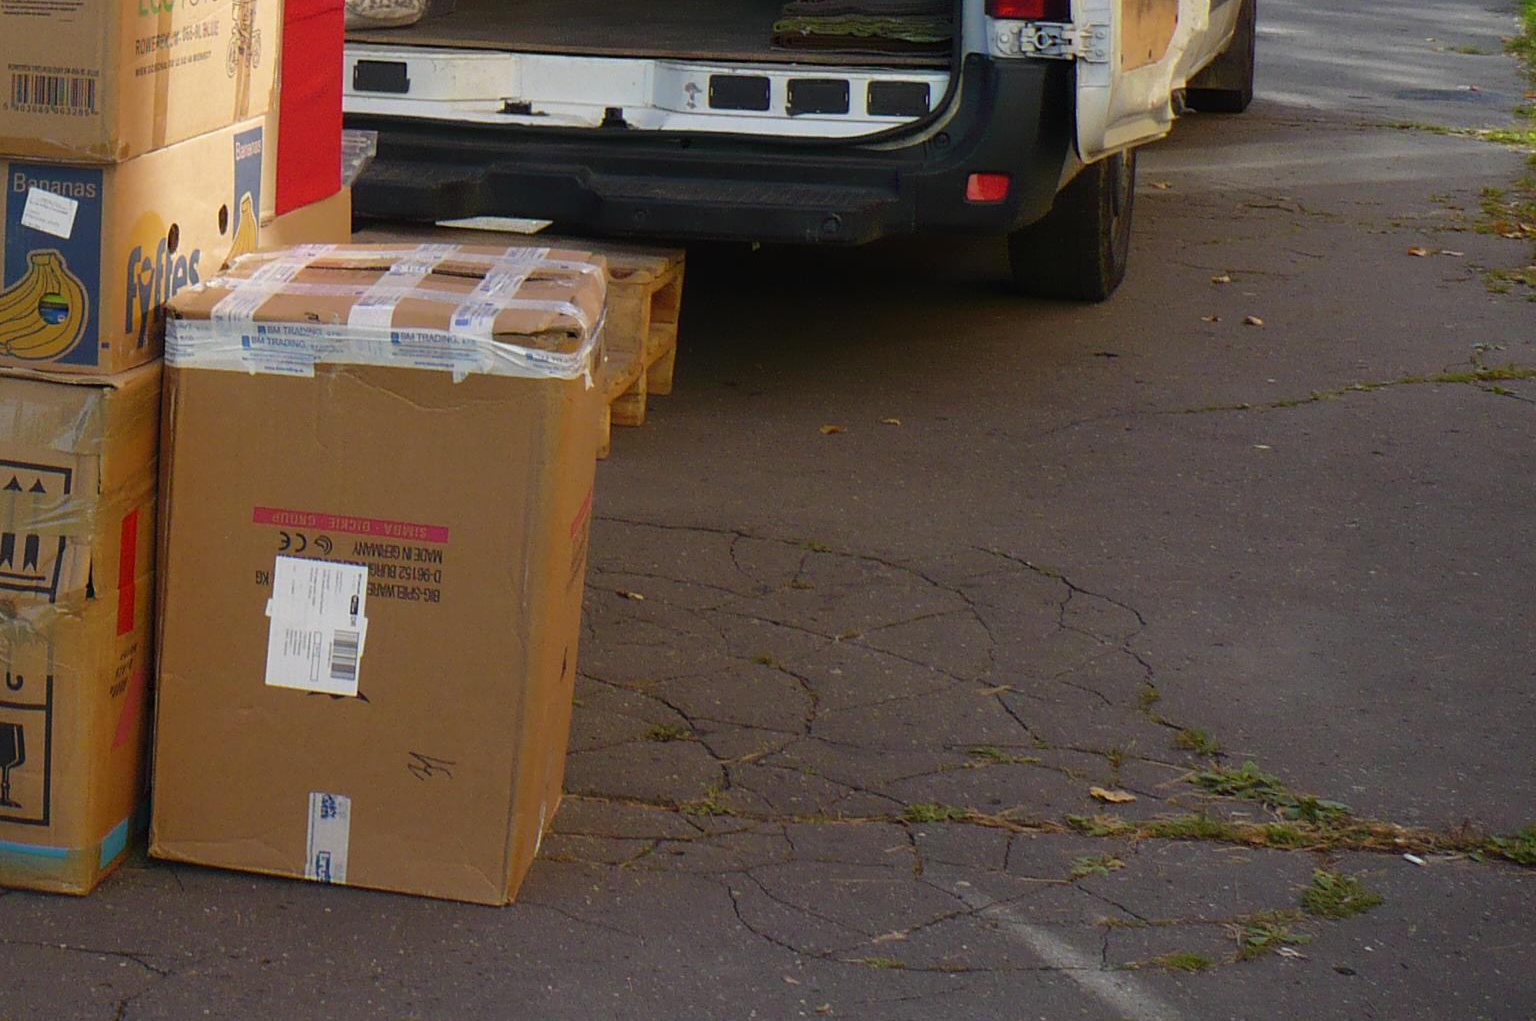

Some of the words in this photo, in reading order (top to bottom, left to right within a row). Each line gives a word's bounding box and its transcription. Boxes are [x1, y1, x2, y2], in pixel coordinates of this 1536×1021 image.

[235, 139, 262, 161] Bananas
[13, 172, 96, 198] Bananas
[272, 513, 316, 527] GROUP
[329, 517, 371, 532] DICKIE
[352, 542, 401, 560] GERMANY
[402, 547, 412, 561] IN
[414, 549, 443, 564] MADE
[255, 570, 270, 585] KG
[368, 583, 441, 602] BIG-SPIELWARE
